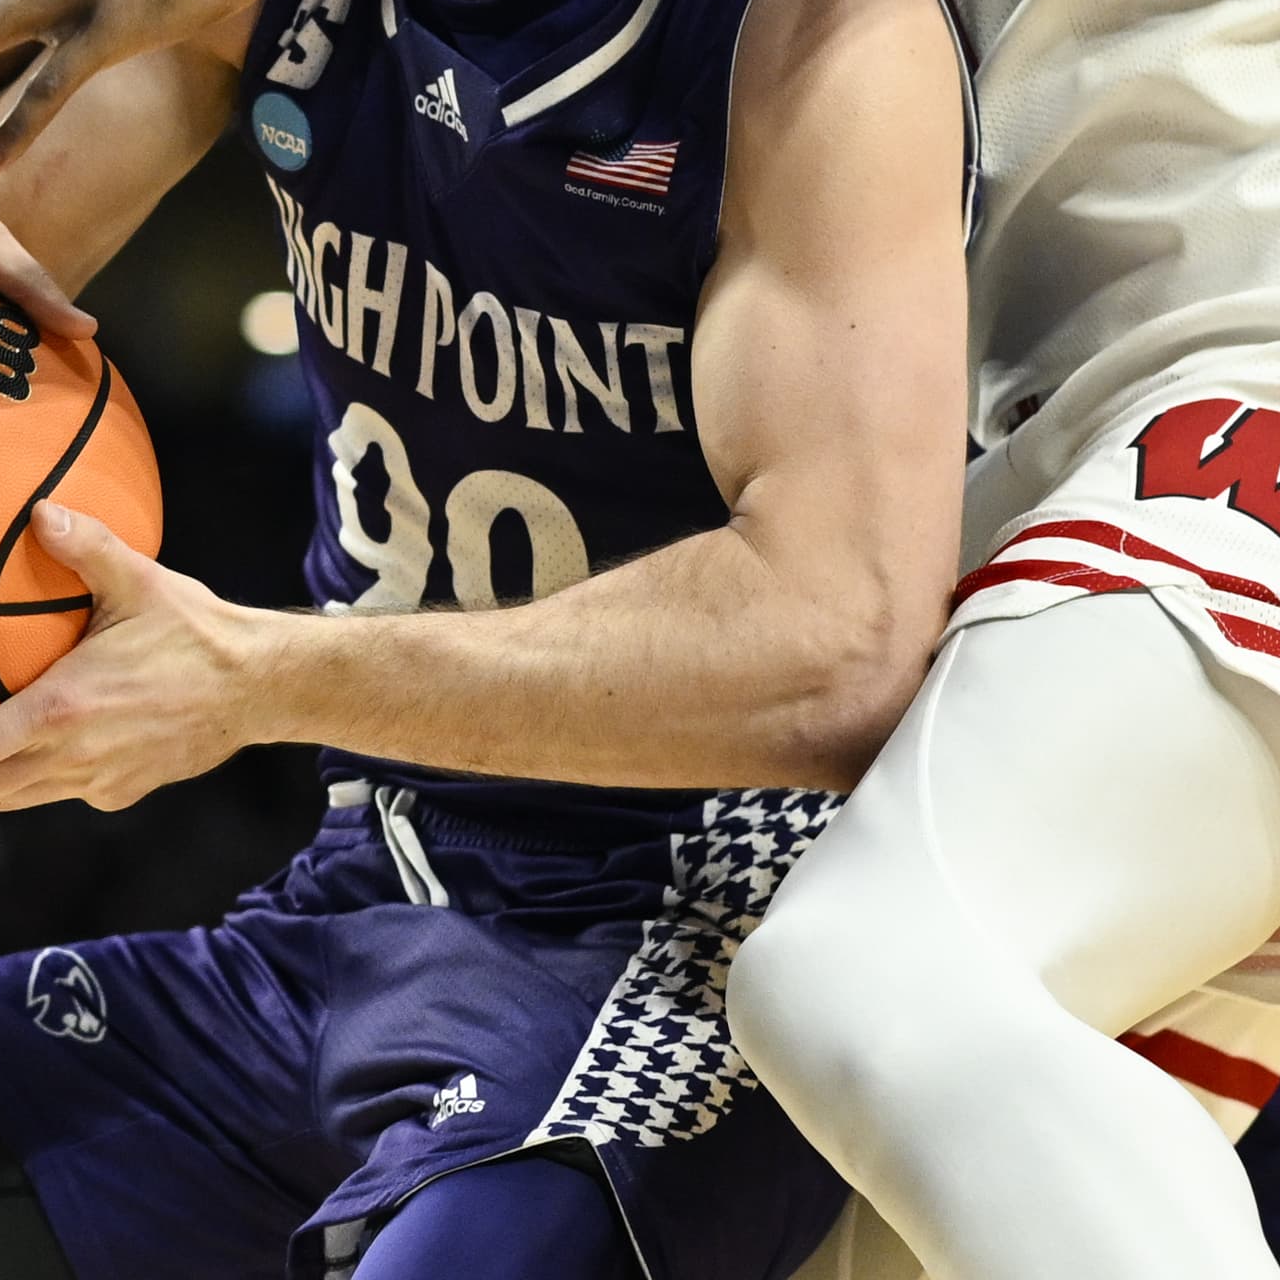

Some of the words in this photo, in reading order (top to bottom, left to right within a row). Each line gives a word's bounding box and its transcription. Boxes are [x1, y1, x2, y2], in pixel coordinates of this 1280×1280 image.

[261, 124, 308, 159] NCAA
[414, 94, 469, 143] adidas
[416, 260, 686, 433] POINT
[327, 402, 590, 611] 90
[432, 1096, 486, 1128] didas
